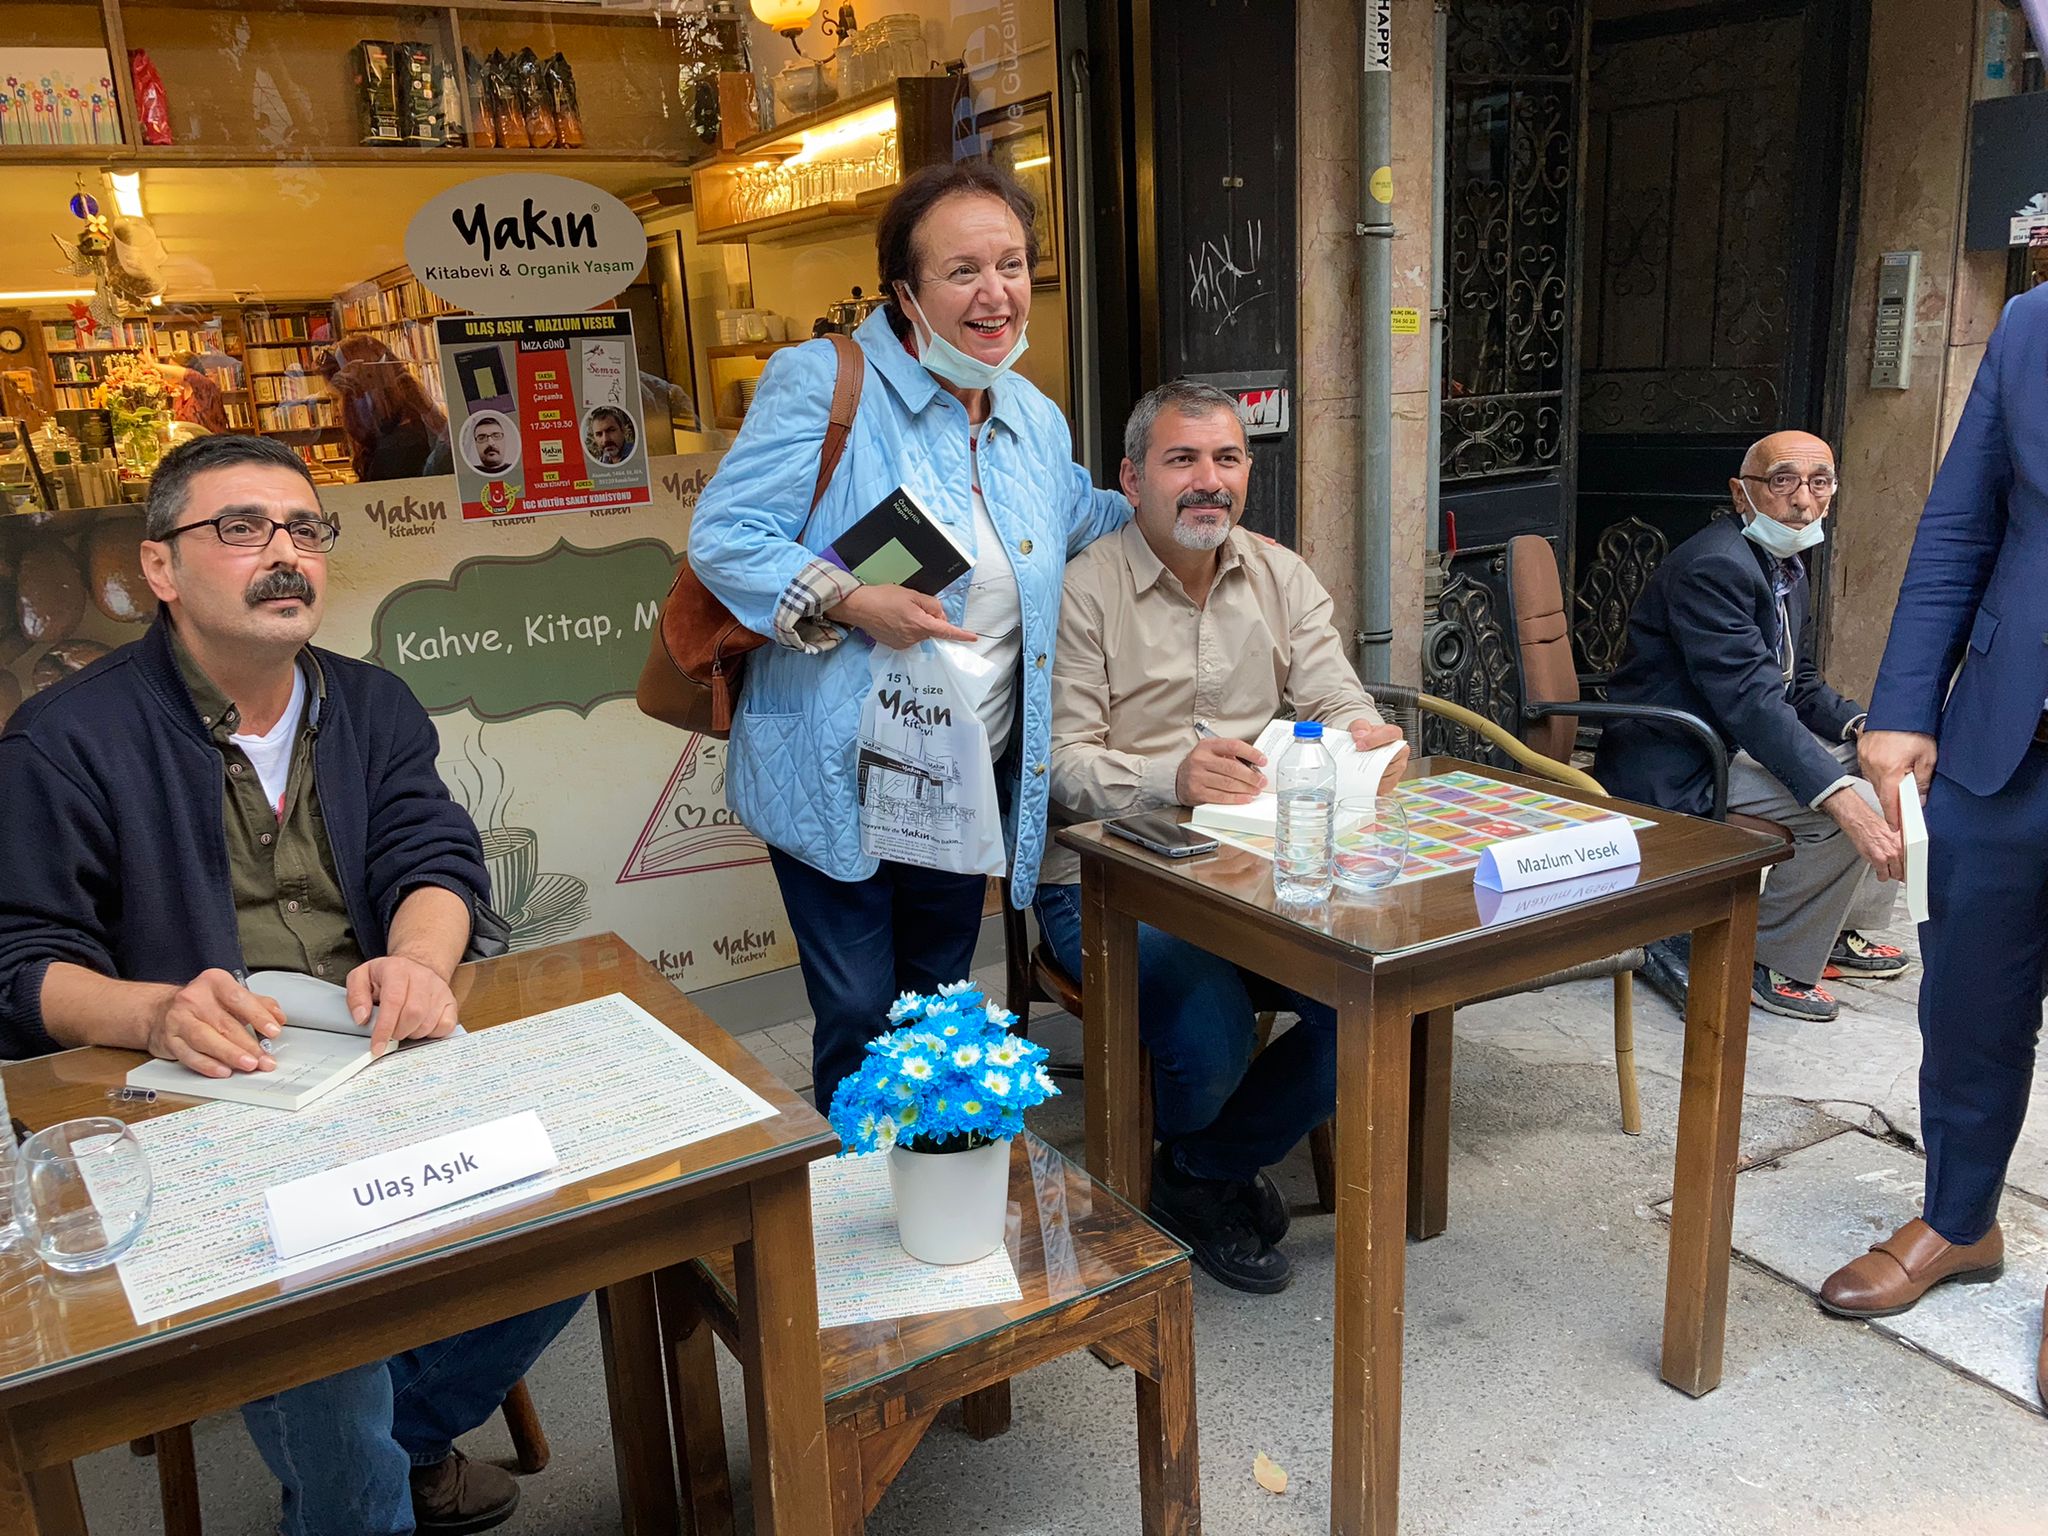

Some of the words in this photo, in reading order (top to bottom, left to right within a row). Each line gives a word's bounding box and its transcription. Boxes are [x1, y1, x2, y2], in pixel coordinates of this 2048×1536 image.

[1376, 0, 1390, 68] HAPPY
[1007, 104, 1025, 136] ve
[425, 263, 494, 280] Kitabevi
[499, 264, 511, 276] &
[517, 262, 580, 278] Organik
[583, 260, 634, 275] Yaşam
[465, 321, 495, 337] ULAŞ
[497, 320, 524, 336] AŞIK
[535, 318, 581, 333] MAZLUM
[583, 316, 616, 330] VESEK
[521, 340, 542, 350] İMZA
[543, 339, 565, 350] GÜNÜ
[537, 497, 565, 509] KÜLTÜR
[566, 495, 588, 506] SANAT
[589, 492, 632, 504] KOMİSYONU
[396, 626, 513, 665] Kahve,
[525, 613, 622, 647] Kitap,
[887, 672, 902, 683] 15
[922, 685, 944, 695] size
[1516, 853, 1573, 875] Mazlum
[1574, 841, 1620, 863] Vesek
[353, 1174, 414, 1207] Ulaş
[422, 1152, 479, 1186] Aşık
